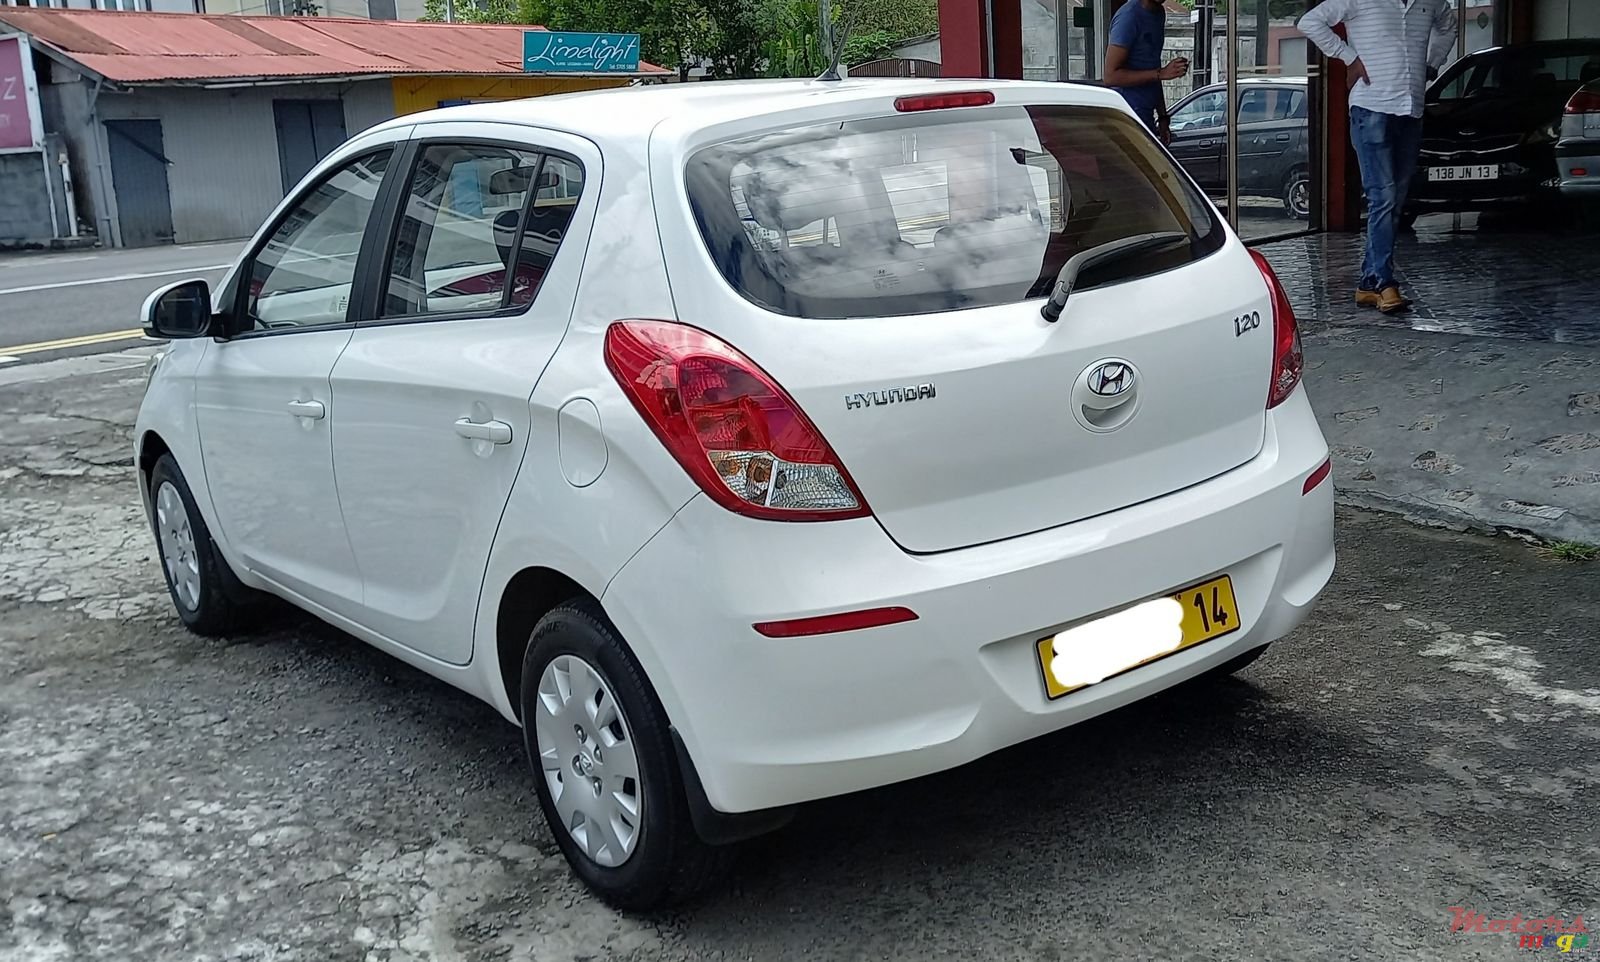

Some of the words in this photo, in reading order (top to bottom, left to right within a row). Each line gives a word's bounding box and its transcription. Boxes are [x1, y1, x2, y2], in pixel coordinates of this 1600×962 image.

[527, 35, 637, 70] Limelight
[1435, 168, 1454, 179] 138
[1458, 167, 1472, 179] JN
[1477, 166, 1490, 178] 13
[845, 383, 936, 410] HYUNDAI
[1193, 586, 1228, 632] 14
